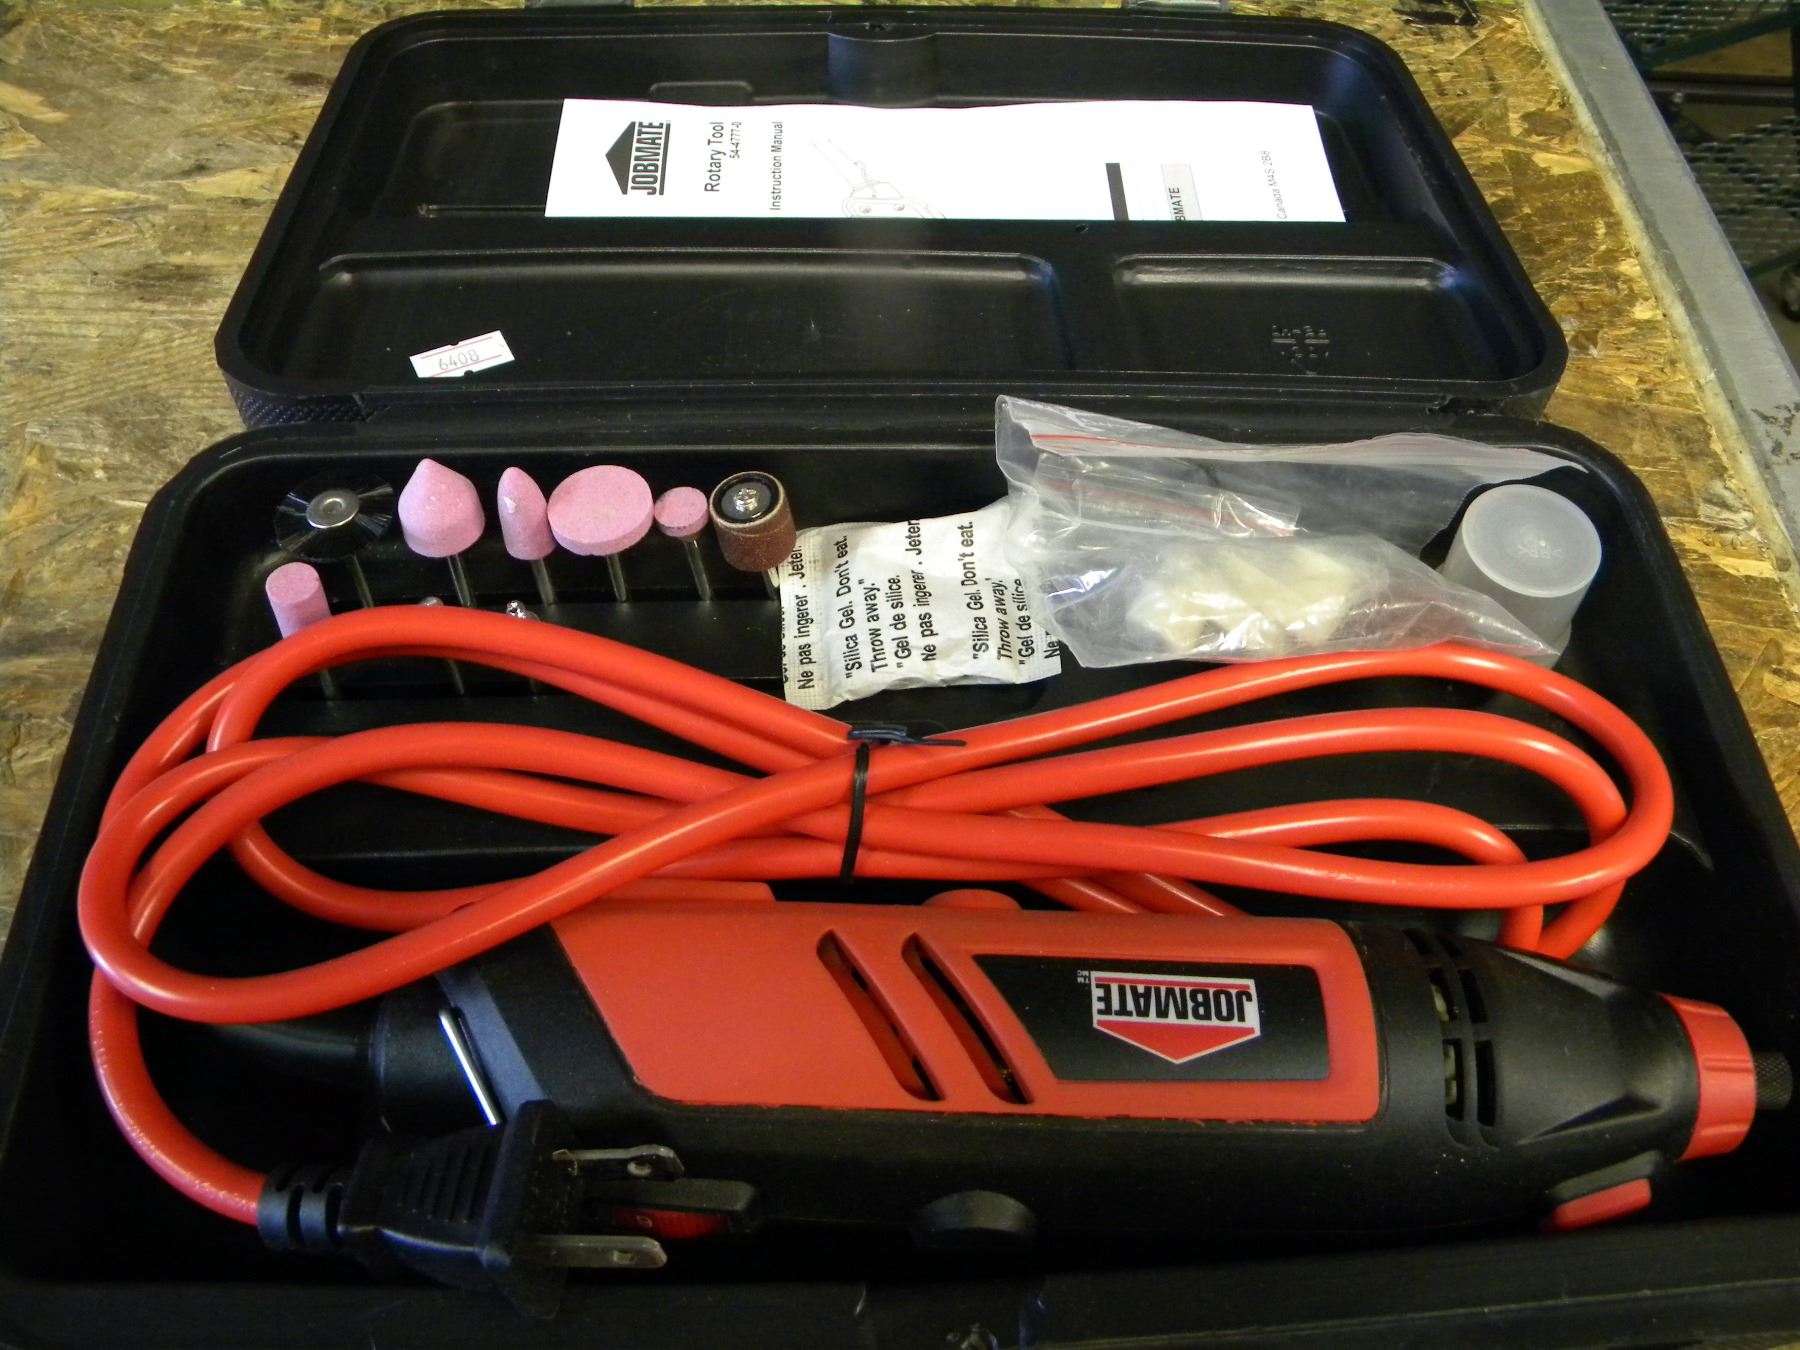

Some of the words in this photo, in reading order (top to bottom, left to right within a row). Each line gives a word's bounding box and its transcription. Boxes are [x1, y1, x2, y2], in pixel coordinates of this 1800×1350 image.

[707, 121, 724, 147] Tool
[729, 121, 742, 159] 54-4777-0
[771, 121, 783, 153] Manual
[630, 121, 665, 196] JOBMATE
[704, 150, 726, 193] Rotary
[769, 155, 782, 211] Instruction
[1265, 168, 1278, 186] M4S
[1272, 189, 1287, 219] Canada
[439, 349, 480, 371] 6408
[833, 535, 848, 559] eat.
[957, 521, 974, 548] eat.
[834, 560, 851, 598] Don't
[957, 552, 978, 588] Don't
[885, 575, 904, 610] silice.
[911, 569, 932, 607] ingerer
[964, 589, 984, 611] Gel.
[794, 594, 814, 639] ingerer
[837, 600, 855, 630] Gel.
[889, 613, 907, 631] de
[918, 612, 939, 638] pas
[1015, 615, 1032, 631] de
[798, 643, 816, 665] pas
[868, 628, 888, 673] Throw
[920, 644, 937, 662] Ne
[972, 617, 990, 660] "Silica
[997, 618, 1013, 660] Throw
[1043, 639, 1061, 659] Ne
[842, 634, 863, 679] "Silica
[797, 669, 815, 690] Ne
[1095, 983, 1253, 1023] JOBMATE
